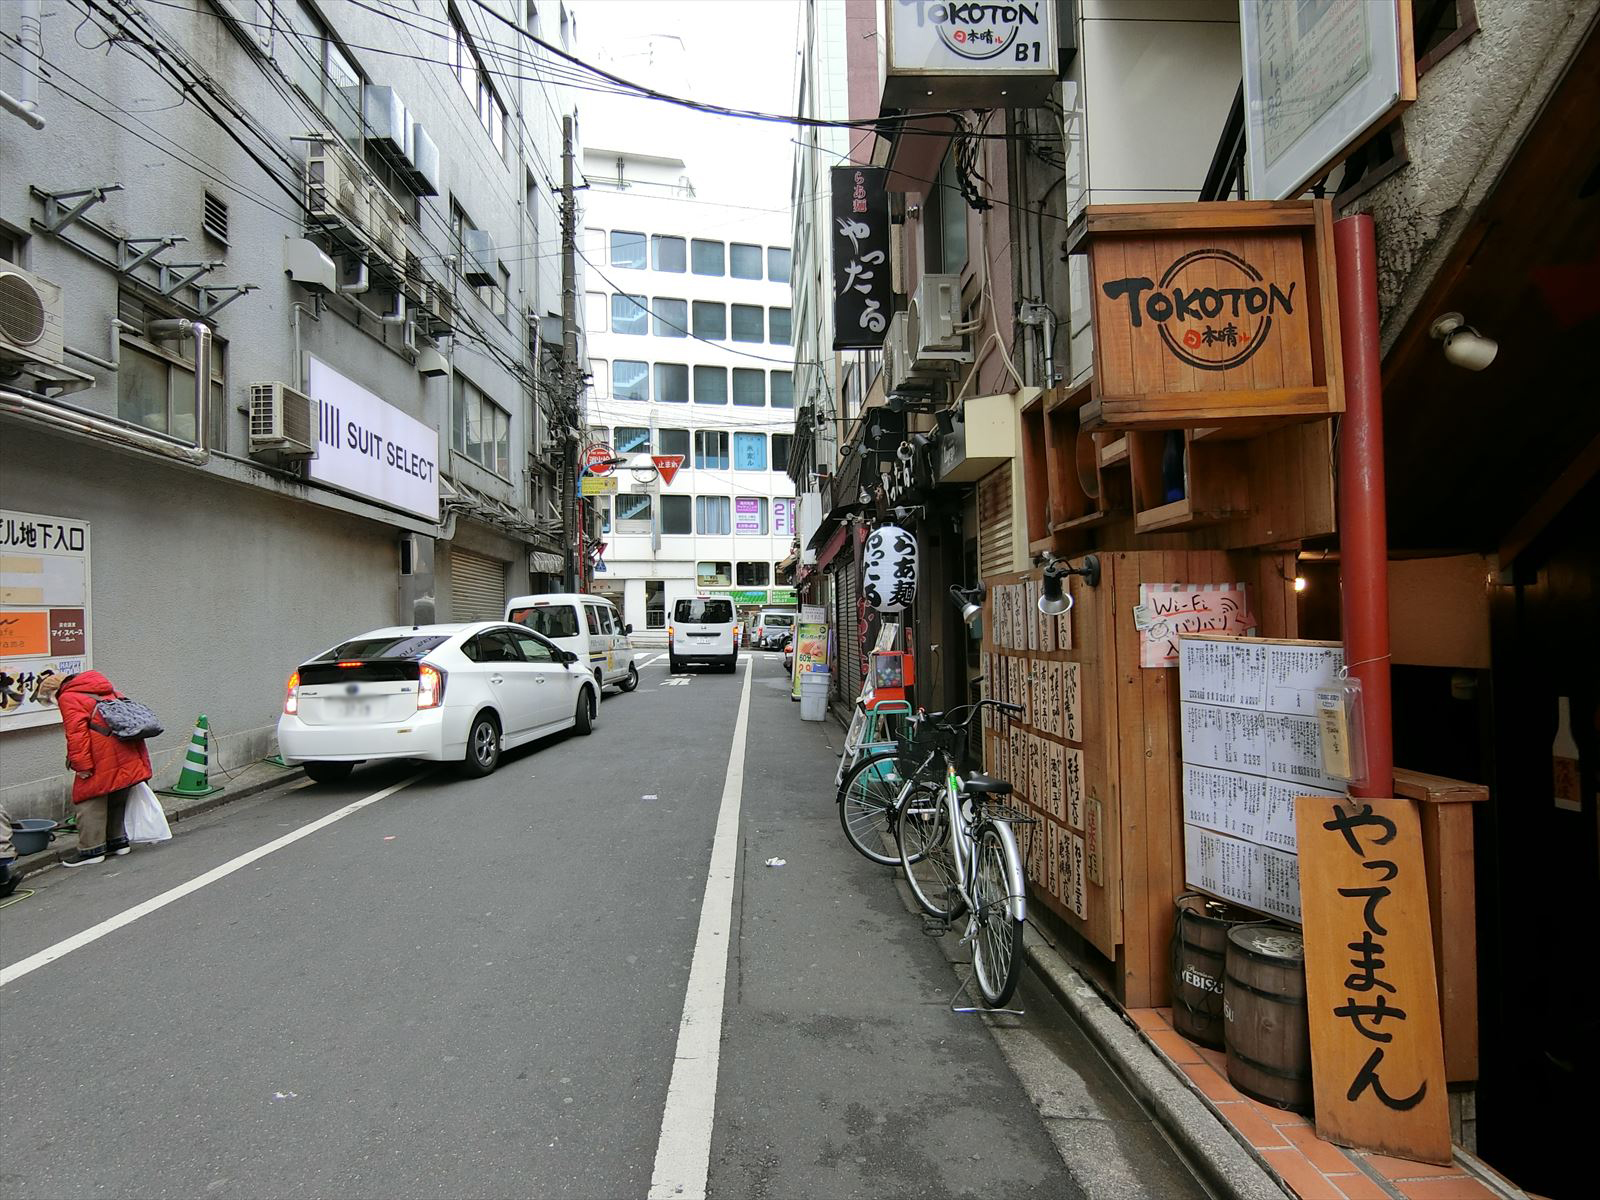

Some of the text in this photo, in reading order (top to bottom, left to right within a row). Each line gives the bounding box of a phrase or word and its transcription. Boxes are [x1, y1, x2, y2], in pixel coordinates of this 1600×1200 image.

[902, 0, 1038, 27] TOKOTON
[1015, 41, 1041, 62] B1
[852, 170, 868, 214] らあ麺
[834, 216, 886, 333] やったる
[1102, 276, 1297, 328] TOKOTON
[347, 421, 434, 484] SUIT SELECT
[658, 461, 678, 469] 止まれ
[0, 518, 84, 551] ル地下入口
[887, 532, 916, 608] らあ麺
[1152, 594, 1209, 616] Wi-Fi
[1322, 803, 1427, 1112] やってません
[1181, 970, 1224, 994] YEBISU
